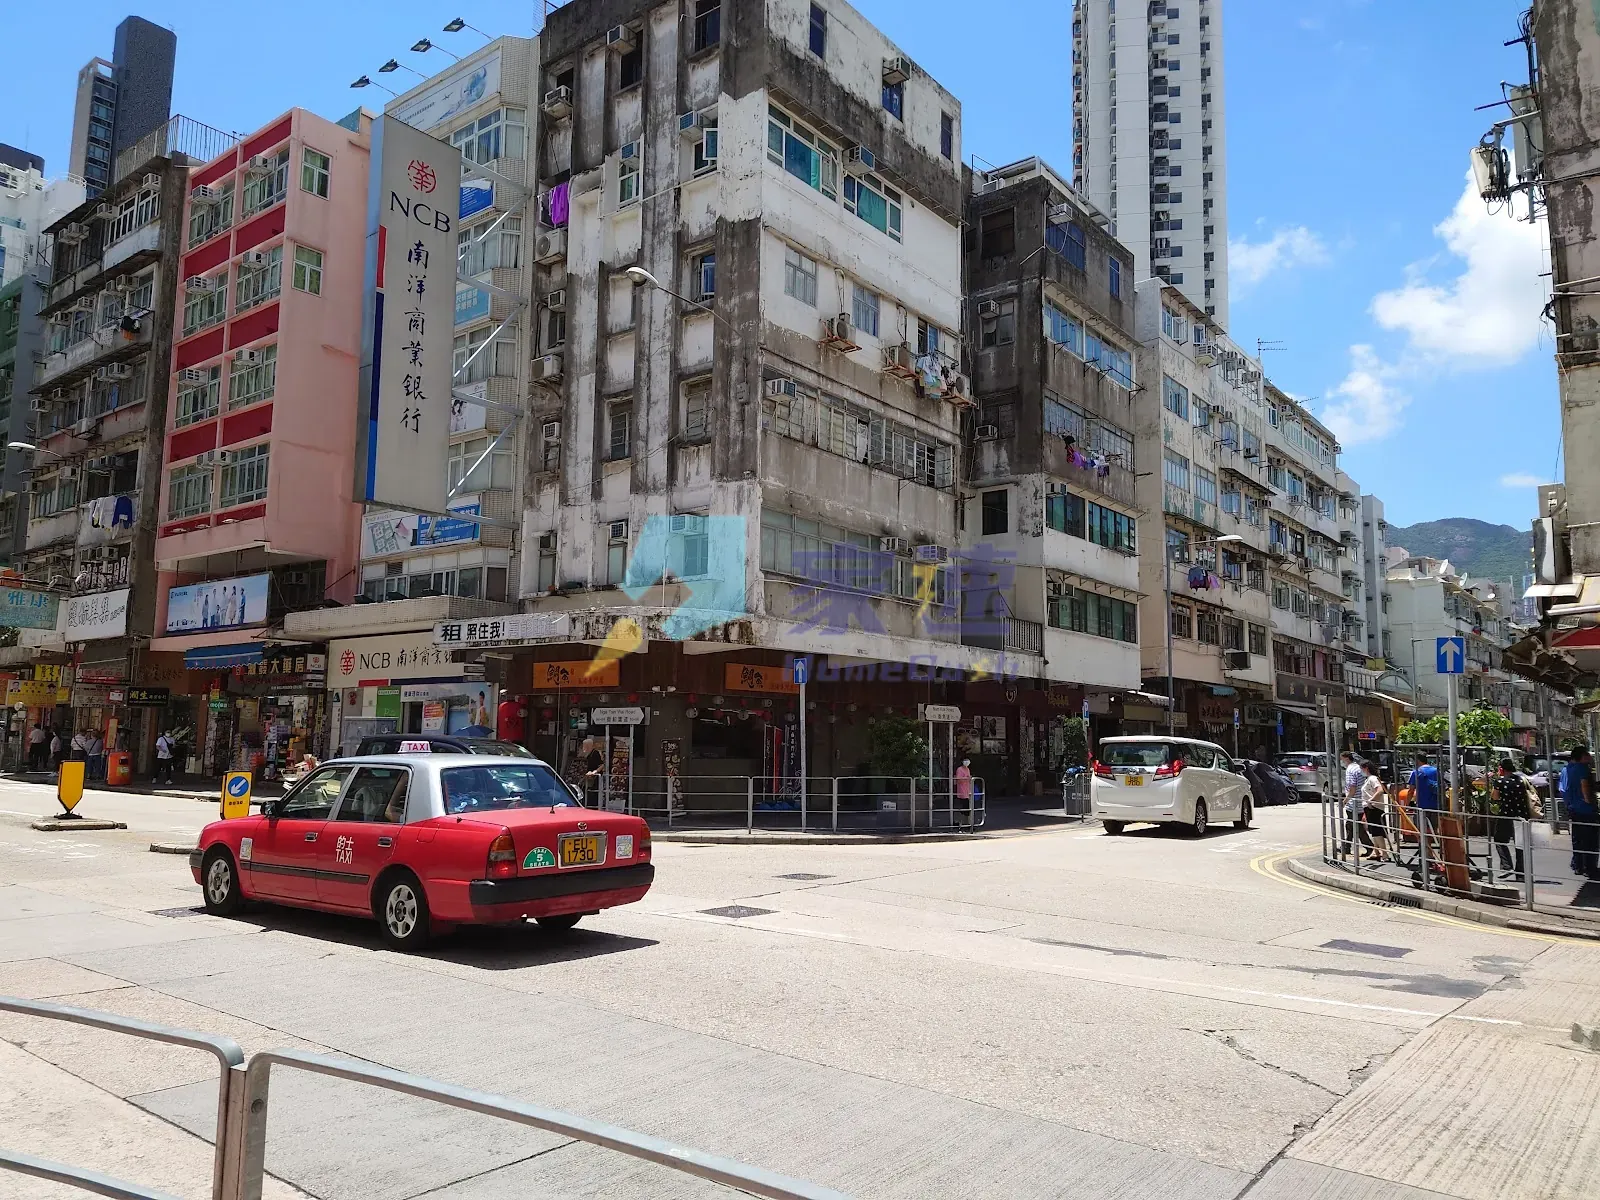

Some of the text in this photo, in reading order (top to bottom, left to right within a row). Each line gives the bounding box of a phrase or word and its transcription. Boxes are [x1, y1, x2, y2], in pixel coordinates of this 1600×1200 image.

[390, 190, 450, 233] NCB
[399, 239, 429, 435] 南洋商業銀行
[441, 624, 461, 641] 租
[359, 652, 391, 669] NCB
[407, 742, 429, 751] TAXI
[336, 835, 354, 850] 的士
[573, 838, 588, 850] EU
[336, 849, 353, 864] TAXI
[567, 850, 594, 863] 1730
